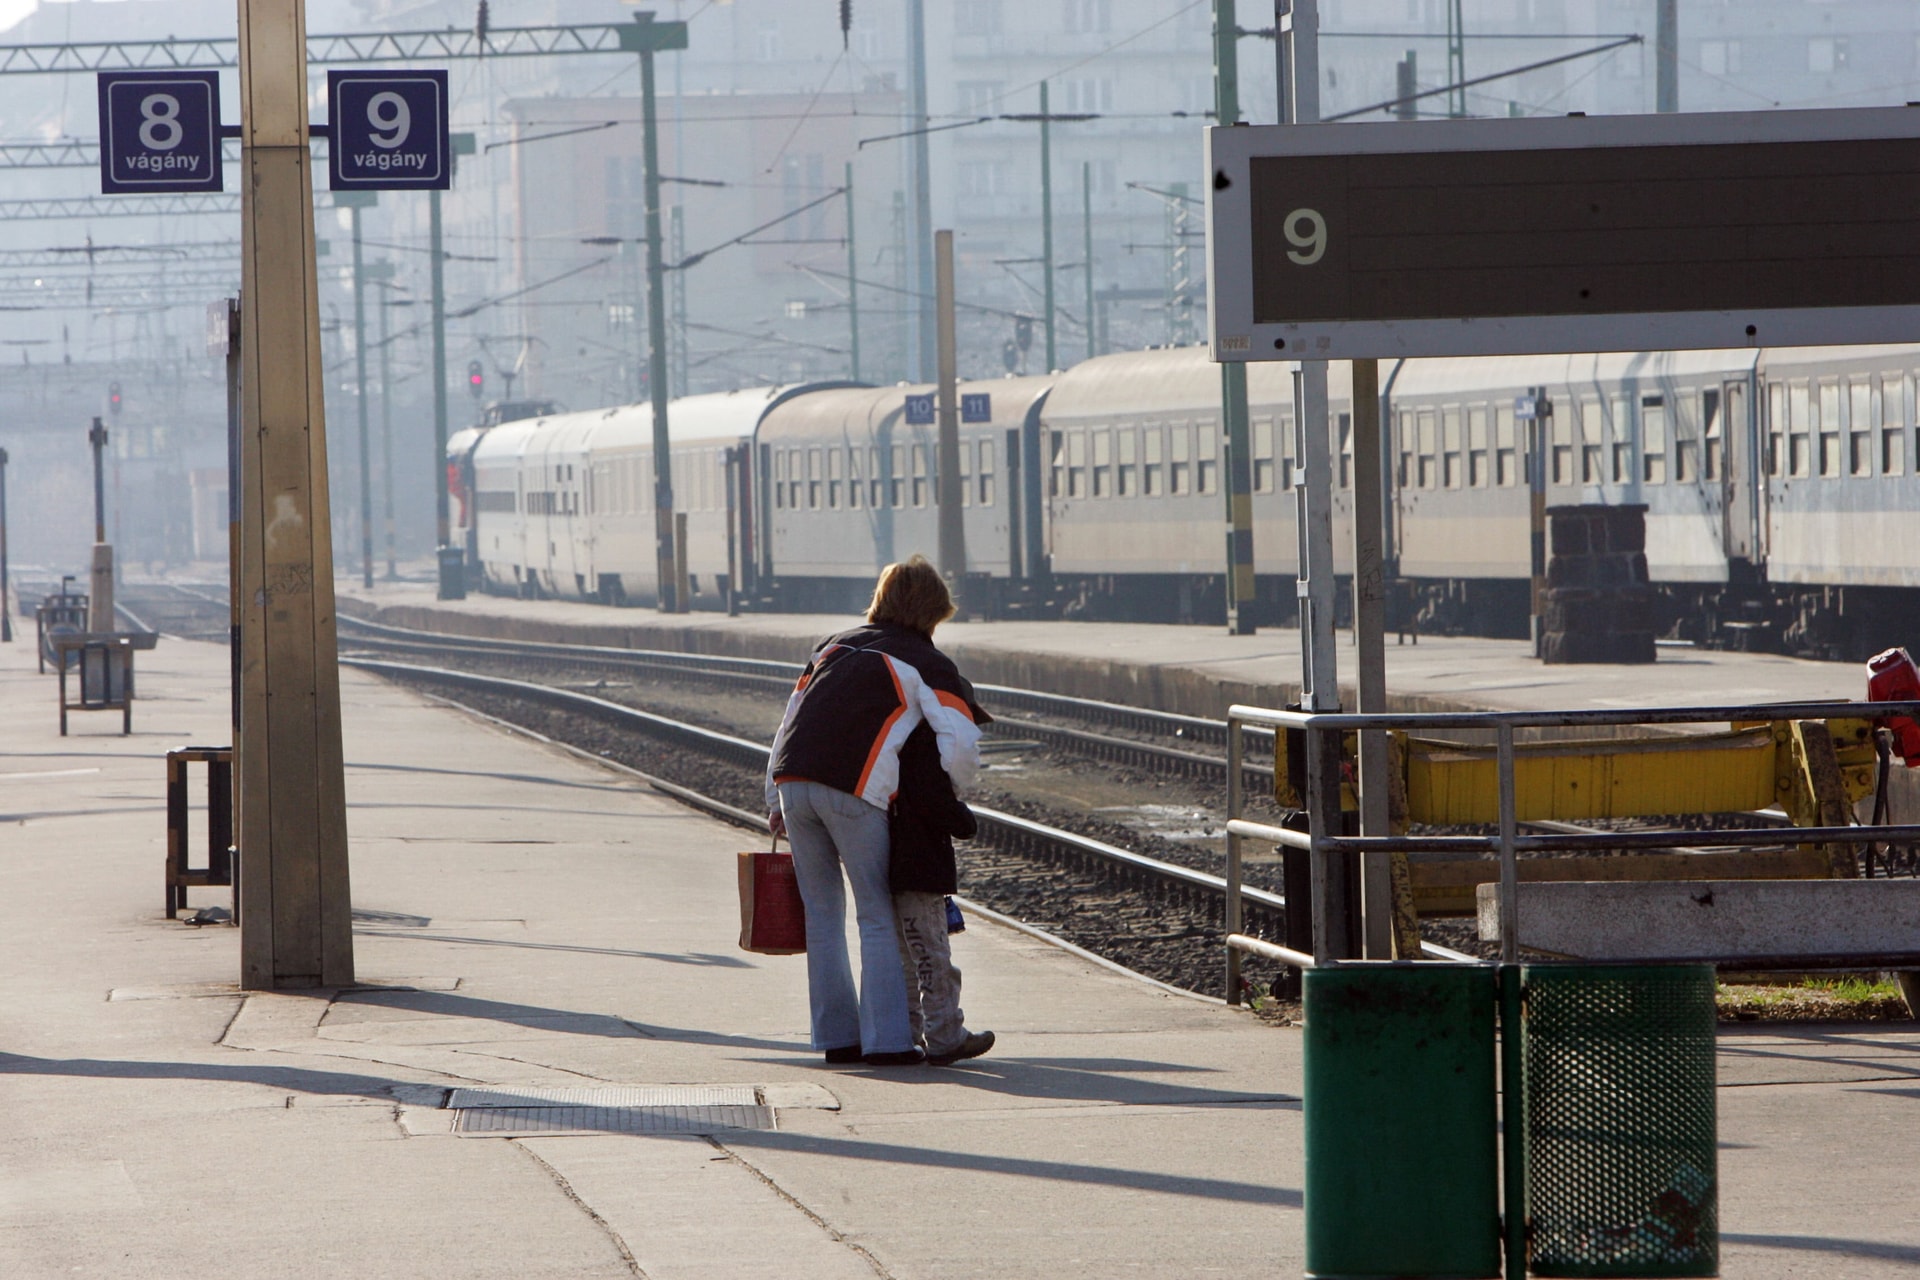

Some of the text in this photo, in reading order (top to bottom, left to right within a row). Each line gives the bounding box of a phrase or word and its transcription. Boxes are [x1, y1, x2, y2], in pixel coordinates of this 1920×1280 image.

[138, 93, 183, 150] 8
[366, 91, 411, 149] 9
[125, 150, 200, 172] vágány
[353, 149, 428, 171] vágány
[1283, 208, 1327, 265] 9
[910, 398, 930, 415] 10
[969, 398, 984, 413] 11
[903, 917, 933, 994] MICKEY
